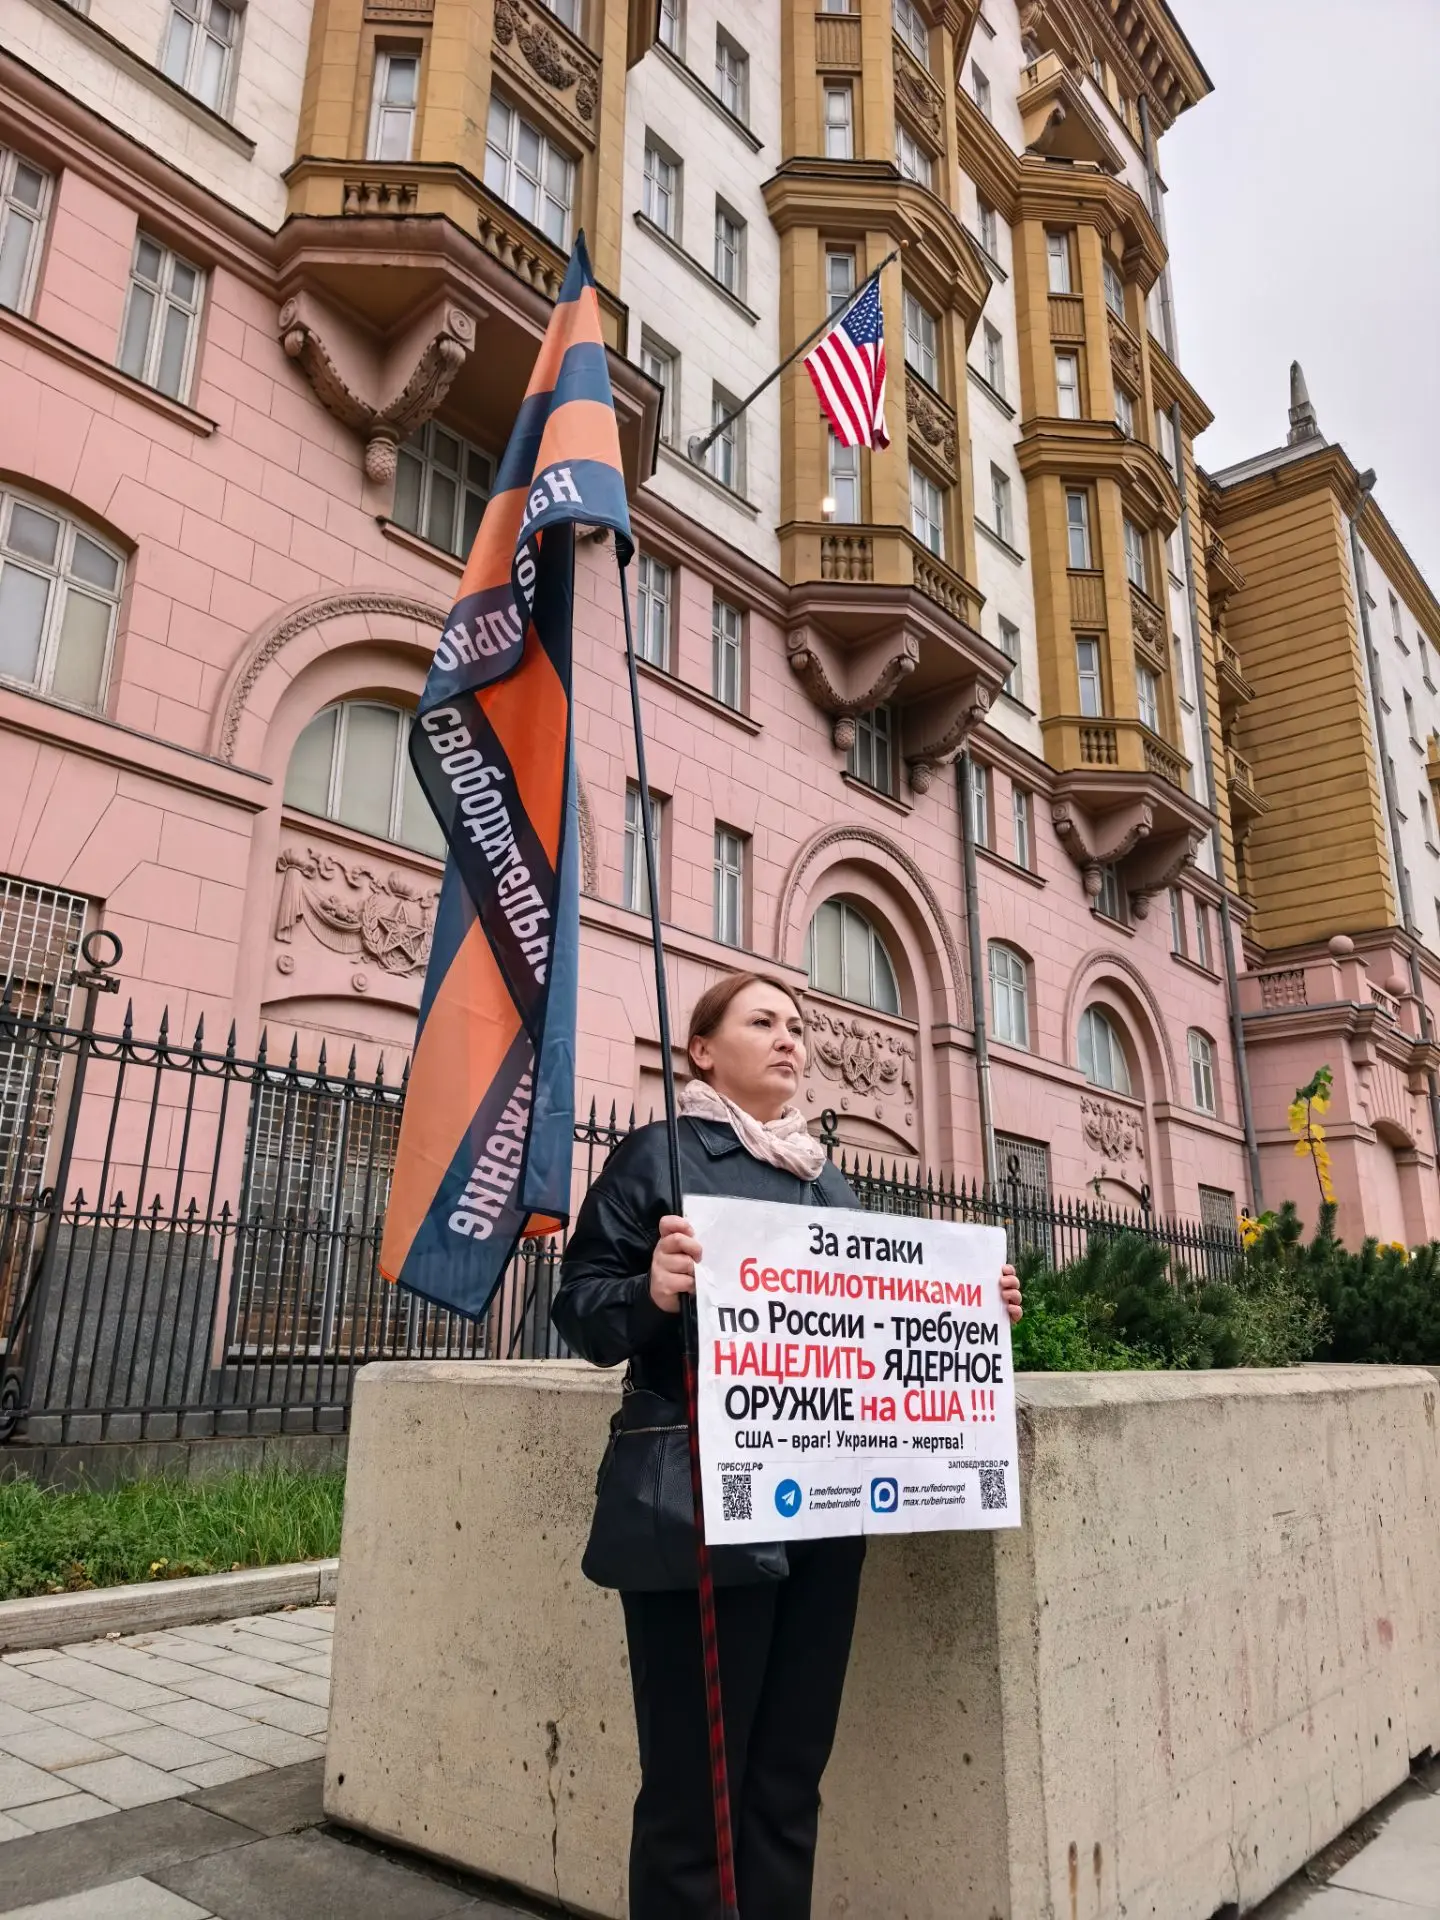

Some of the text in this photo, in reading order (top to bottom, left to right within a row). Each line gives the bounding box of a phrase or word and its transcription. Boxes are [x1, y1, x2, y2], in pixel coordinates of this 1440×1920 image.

[808, 1223, 923, 1265] За атаки
[739, 1257, 982, 1307] беспилотниками
[718, 1306, 759, 1333] по
[768, 1300, 865, 1339] России
[891, 1312, 999, 1348] требуем
[713, 1340, 1003, 1388] НАЦЕЛИТЬ ЯДЕРНОЕ
[725, 1385, 853, 1421] ОРУЖИЕ
[860, 1395, 896, 1422] на
[903, 1389, 965, 1422] США
[735, 1430, 774, 1448] США
[792, 1431, 831, 1452] враг!
[836, 1430, 898, 1452] Украина
[912, 1433, 964, 1453] жертва!
[717, 1462, 764, 1472] ГОРБСУД.РФ
[809, 1485, 862, 1497] t.me/fedorovgd
[902, 1483, 966, 1494] max.ru/fedorovgd
